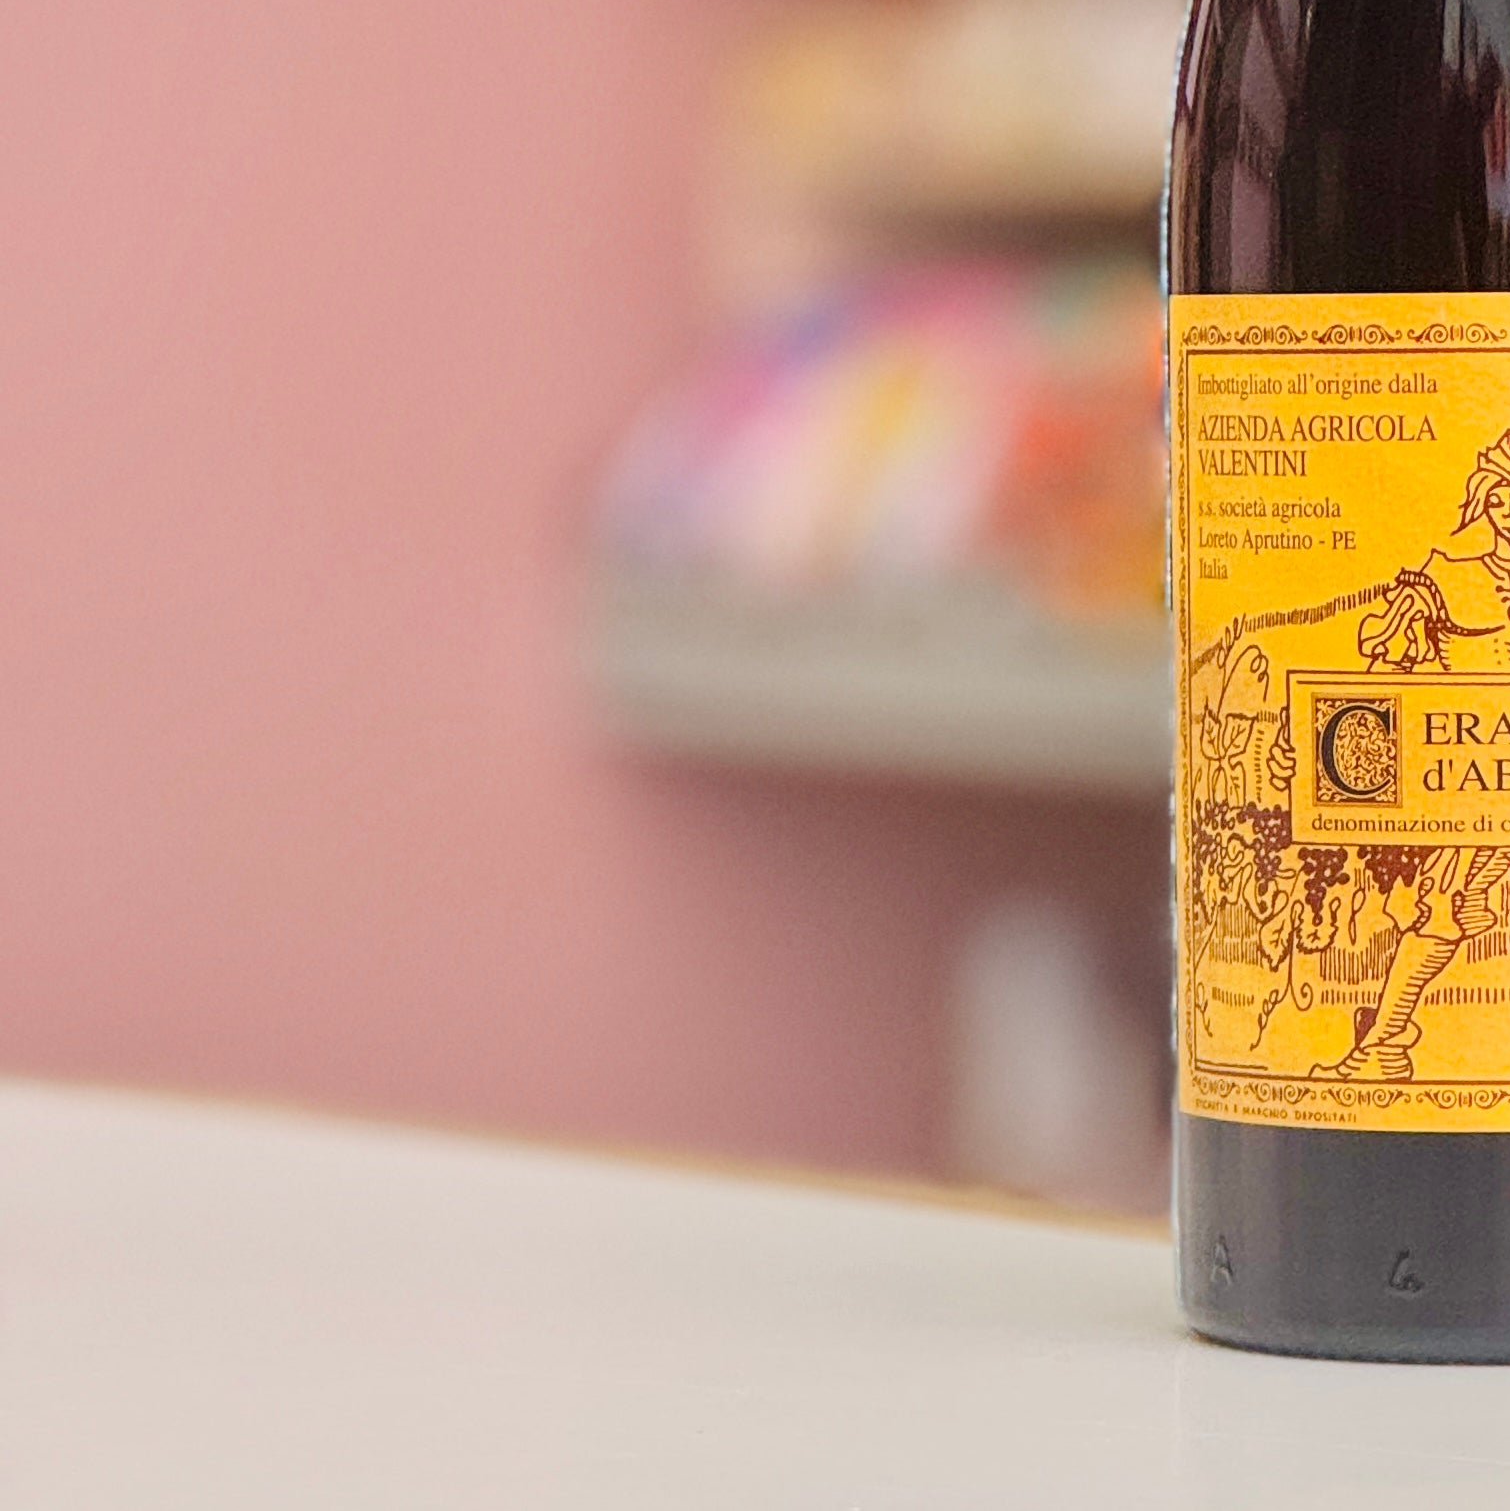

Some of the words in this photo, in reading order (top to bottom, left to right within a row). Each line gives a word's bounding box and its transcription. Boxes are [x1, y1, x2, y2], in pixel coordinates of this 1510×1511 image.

[1197, 373, 1283, 400] Imbottigliato
[1287, 373, 1383, 400] all'origine
[1388, 372, 1438, 395] dalla
[1198, 415, 1286, 441] AZIENDA
[1290, 414, 1438, 442] AGRICOLA
[1198, 449, 1308, 477] VALENTINI
[1218, 496, 1267, 518] società
[1271, 496, 1342, 523] agricola
[1199, 526, 1238, 549] Loreto
[1241, 528, 1313, 555] Aprutino
[1331, 530, 1357, 550] PE
[1199, 558, 1229, 580] Italia
[1311, 812, 1466, 833] denominazione
[1472, 812, 1494, 833] di
[1293, 1110, 1358, 1124] DEPOSITATI
